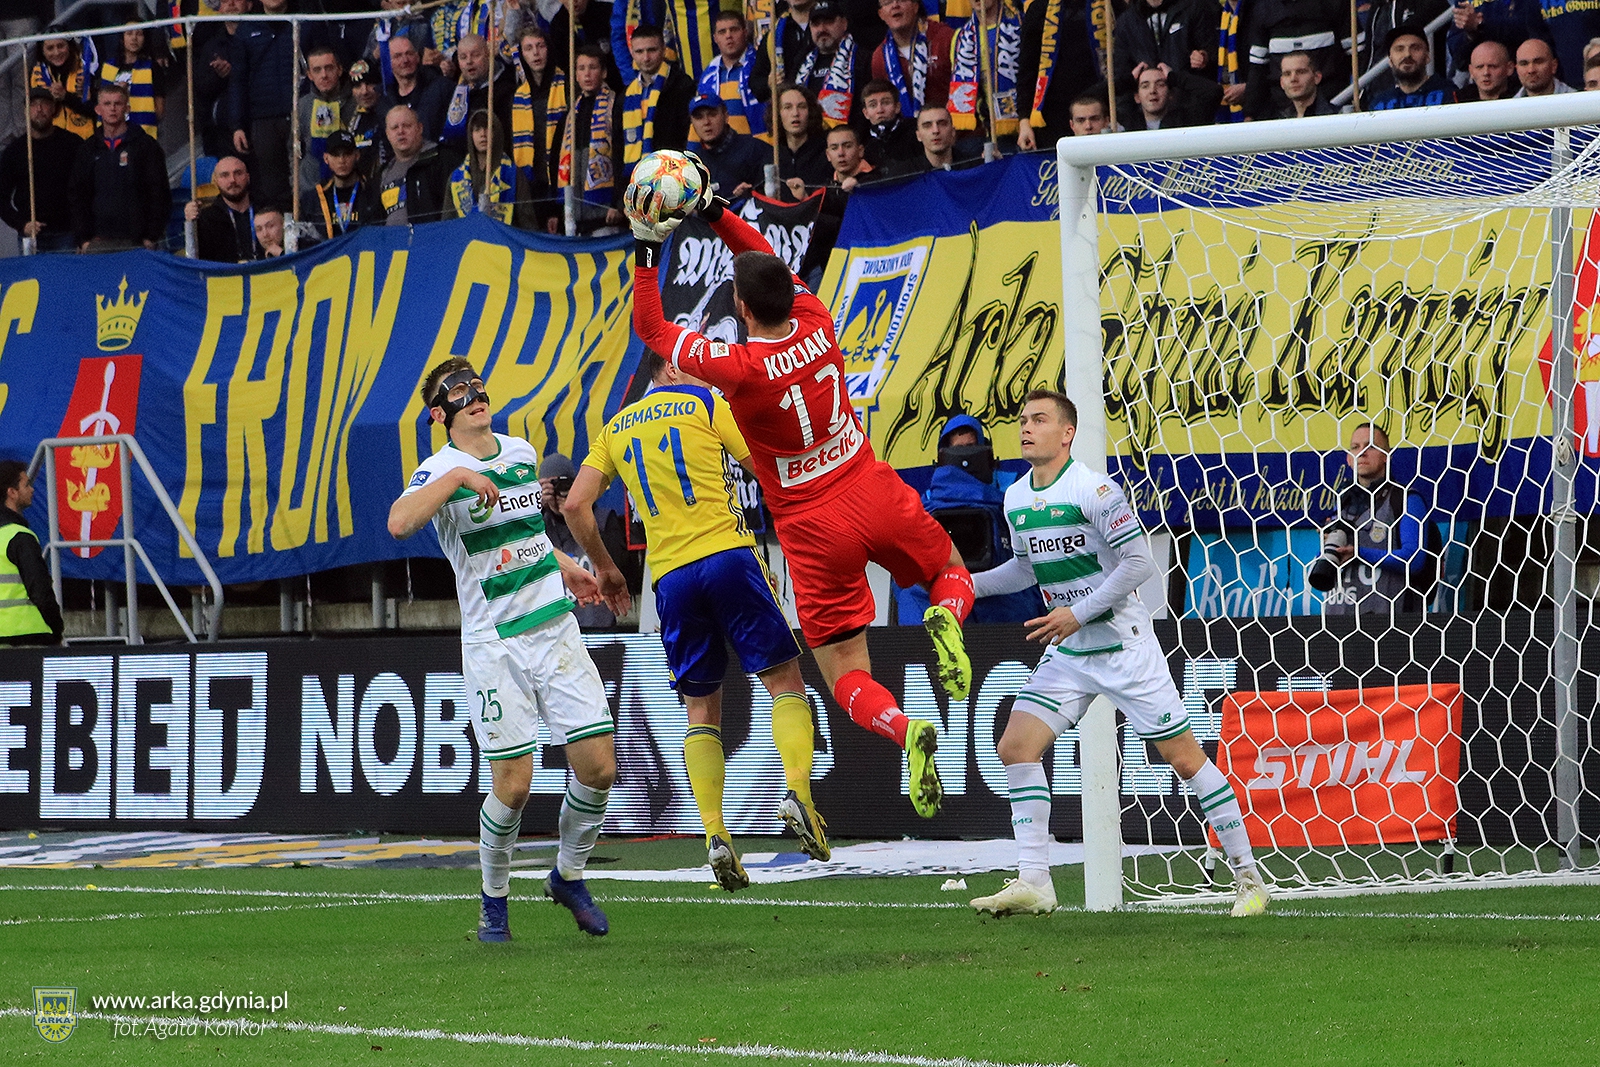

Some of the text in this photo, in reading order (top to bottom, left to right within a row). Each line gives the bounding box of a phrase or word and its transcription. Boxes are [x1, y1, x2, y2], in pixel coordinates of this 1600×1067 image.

[998, 22, 1020, 83] ARKA
[881, 273, 918, 355] SPORTOWY
[883, 218, 1060, 460] Arka
[763, 326, 833, 381] KUCIAK
[178, 250, 409, 559] FROM
[612, 400, 697, 435] SIEMASZKO
[779, 362, 847, 449] 12
[623, 426, 697, 517] 11
[787, 426, 858, 480] Betclic
[1029, 533, 1086, 554] Energa
[1198, 563, 1294, 618] Radio
[477, 688, 503, 723] 25
[40, 652, 268, 819] BET
[1246, 738, 1429, 790] STIHL
